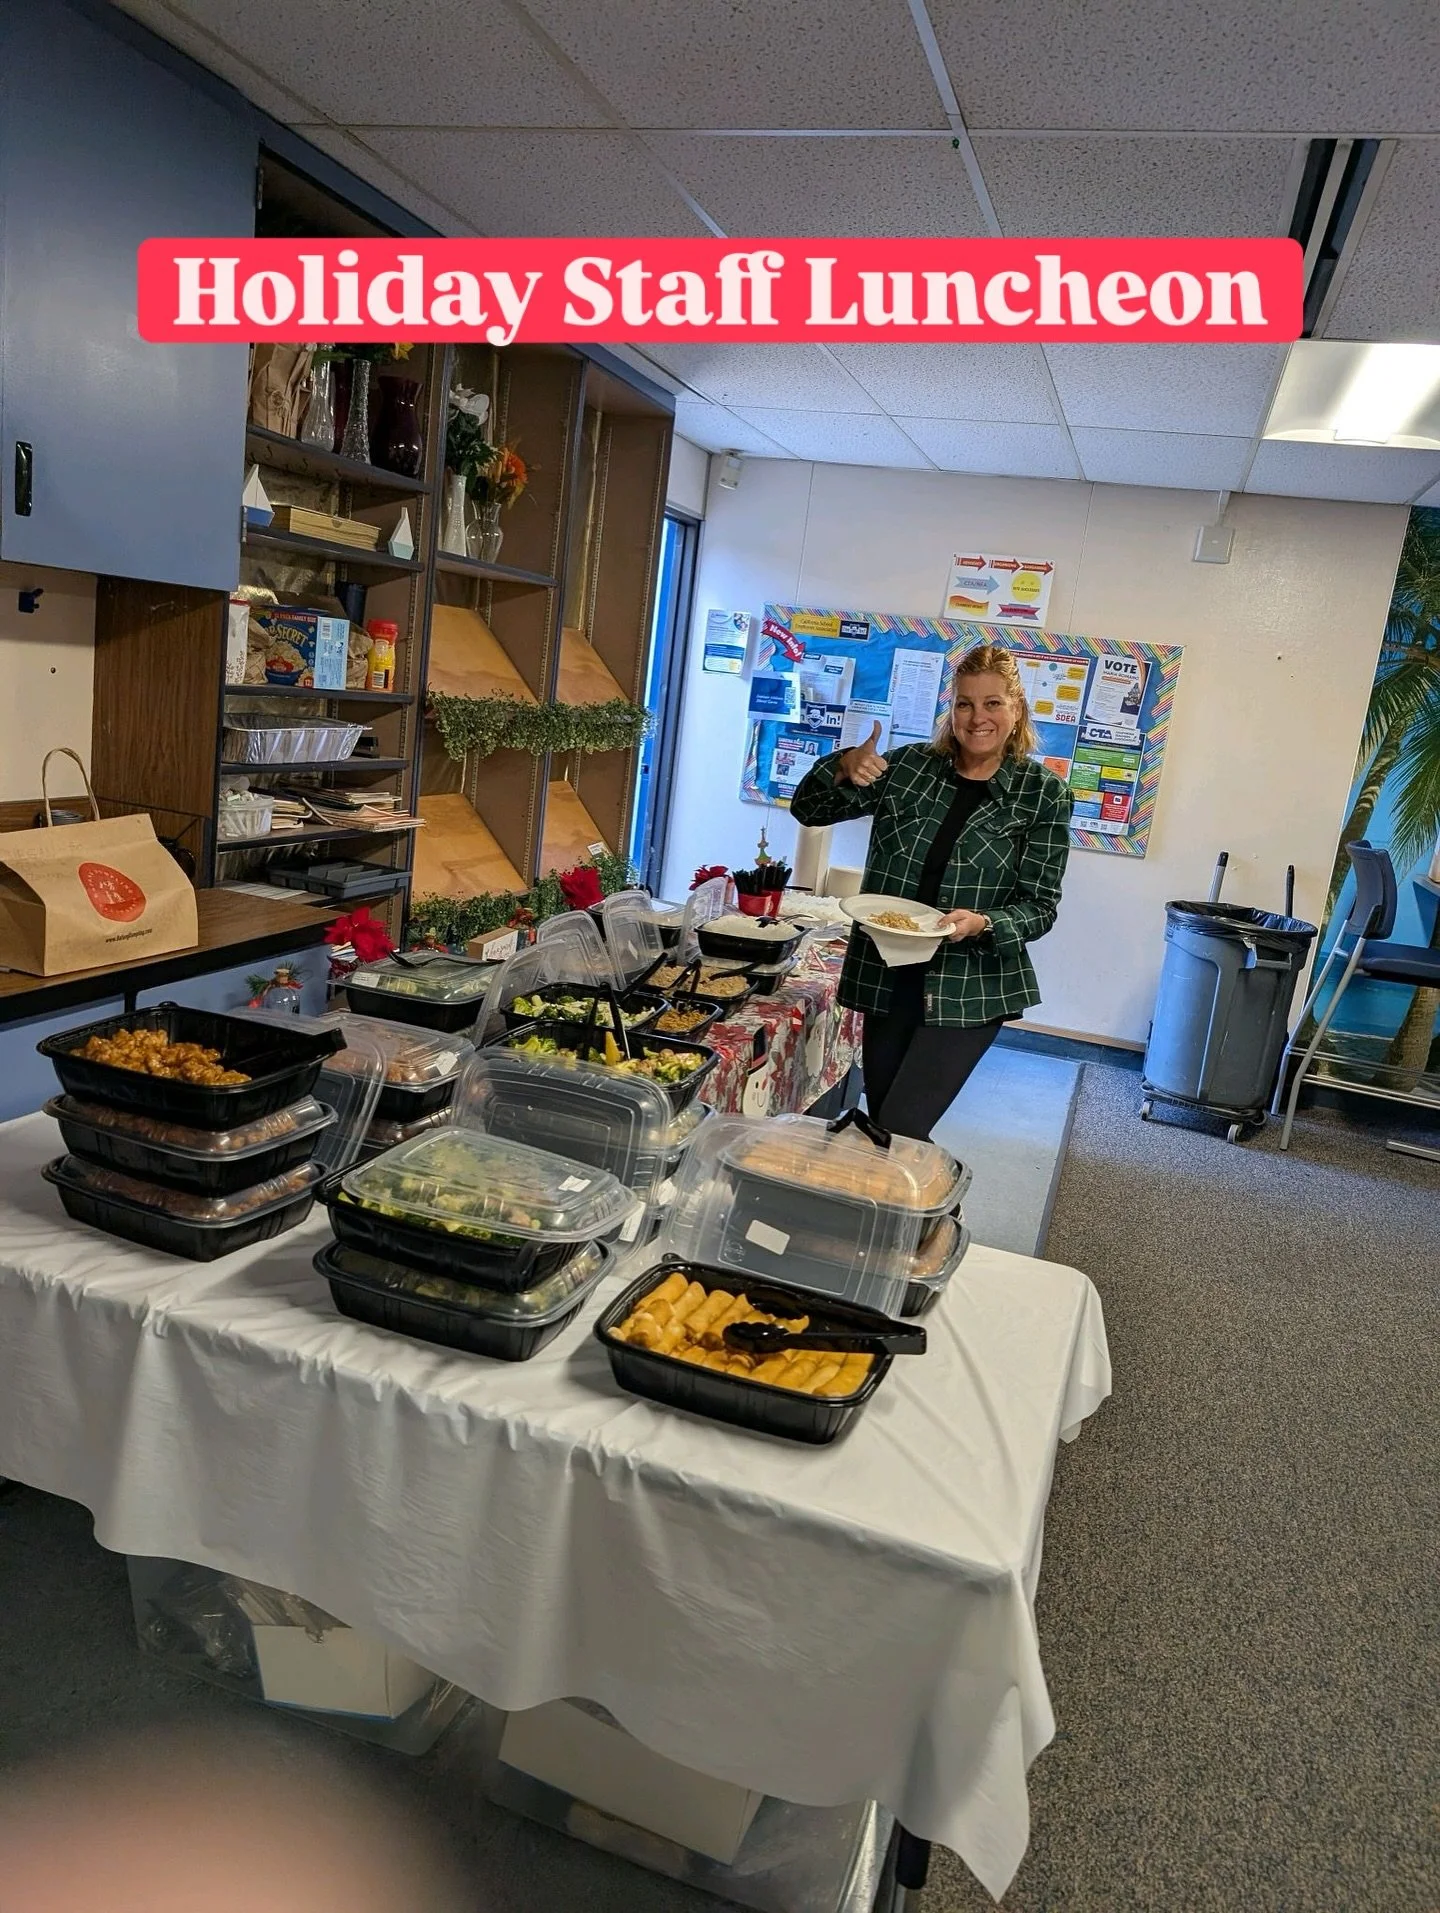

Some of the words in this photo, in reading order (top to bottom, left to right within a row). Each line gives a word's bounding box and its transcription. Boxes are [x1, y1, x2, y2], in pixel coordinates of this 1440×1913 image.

[277, 623, 309, 647] SECRET
[770, 624, 788, 639] New
[786, 636, 802, 657] Info!
[1104, 659, 1138, 674] VOTE
[826, 714, 841, 725] In!
[1055, 714, 1076, 723] SDEA
[1089, 728, 1112, 740] CTA
